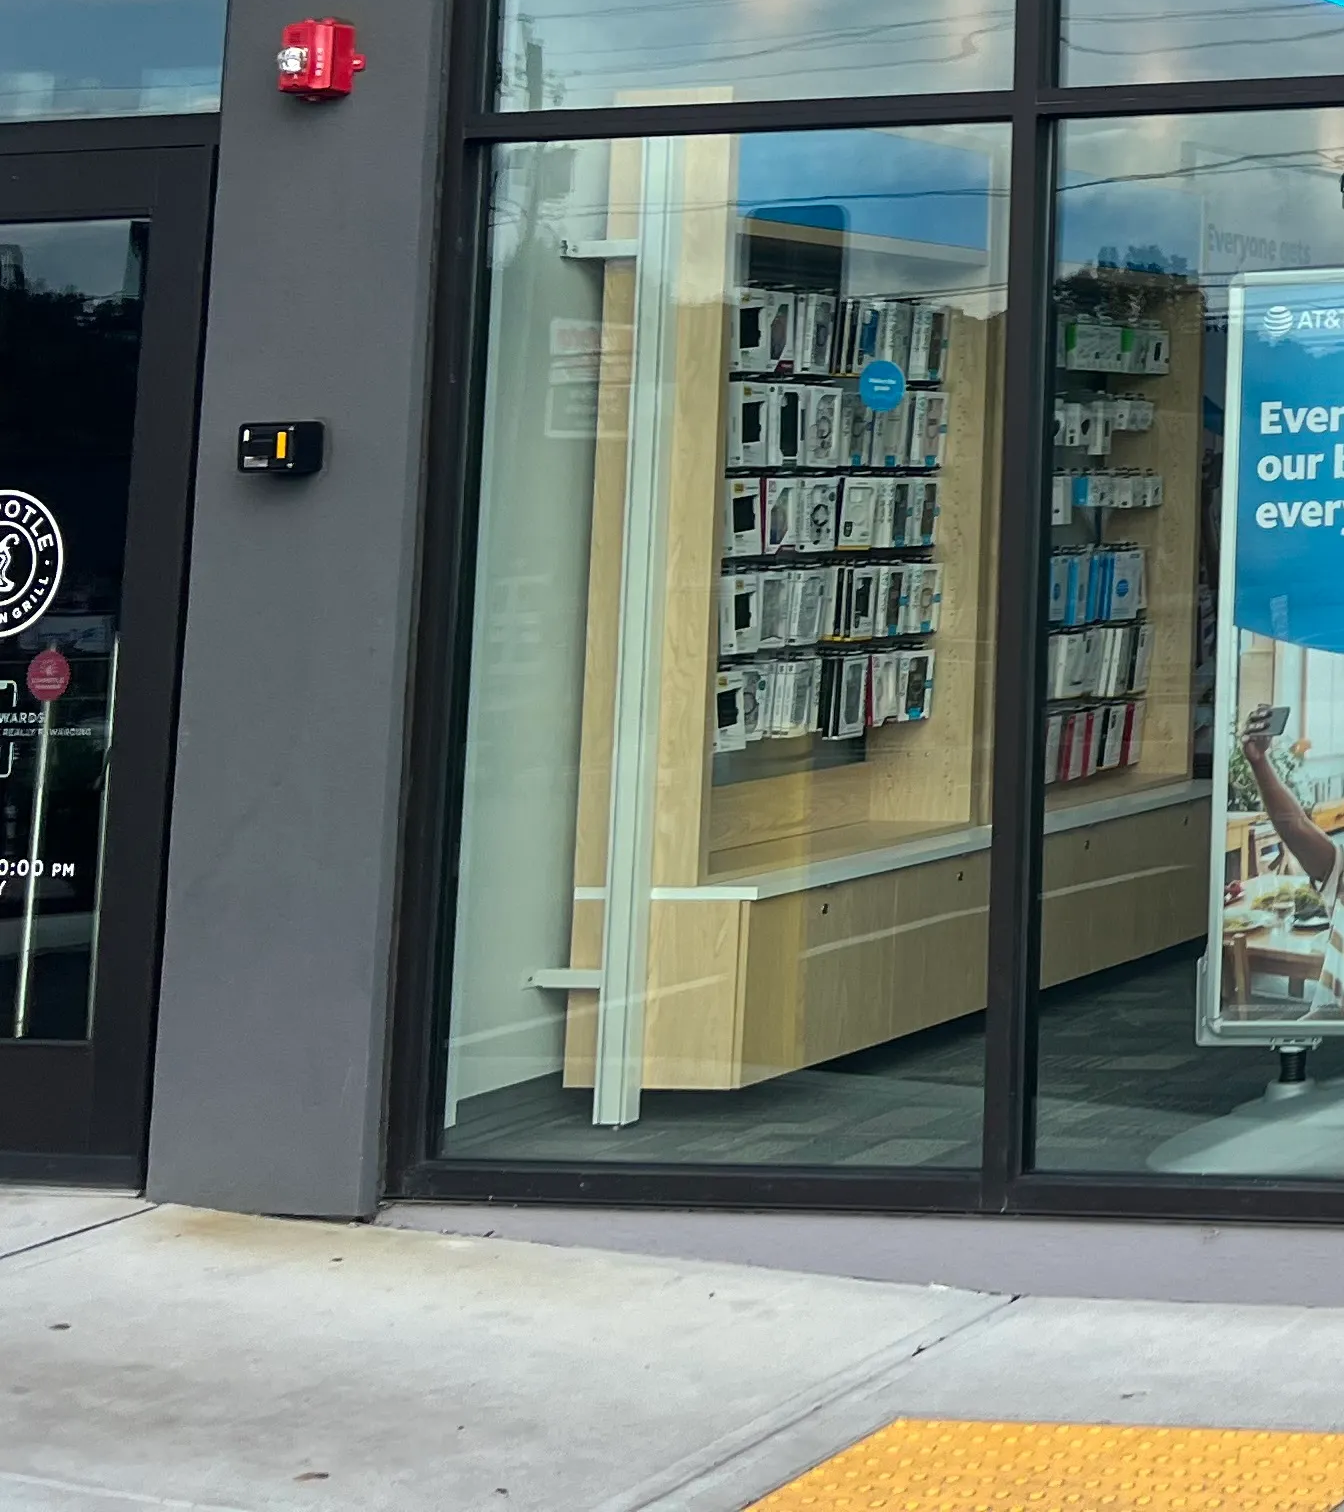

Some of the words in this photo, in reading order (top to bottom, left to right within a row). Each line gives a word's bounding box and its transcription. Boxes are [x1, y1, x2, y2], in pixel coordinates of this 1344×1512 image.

[1257, 451, 1324, 482] our
[0, 499, 54, 552] OTLE
[12, 576, 49, 619] GRILL
[0, 712, 45, 723] WARDS
[0, 858, 44, 877] 0:00
[52, 863, 75, 877] PM
